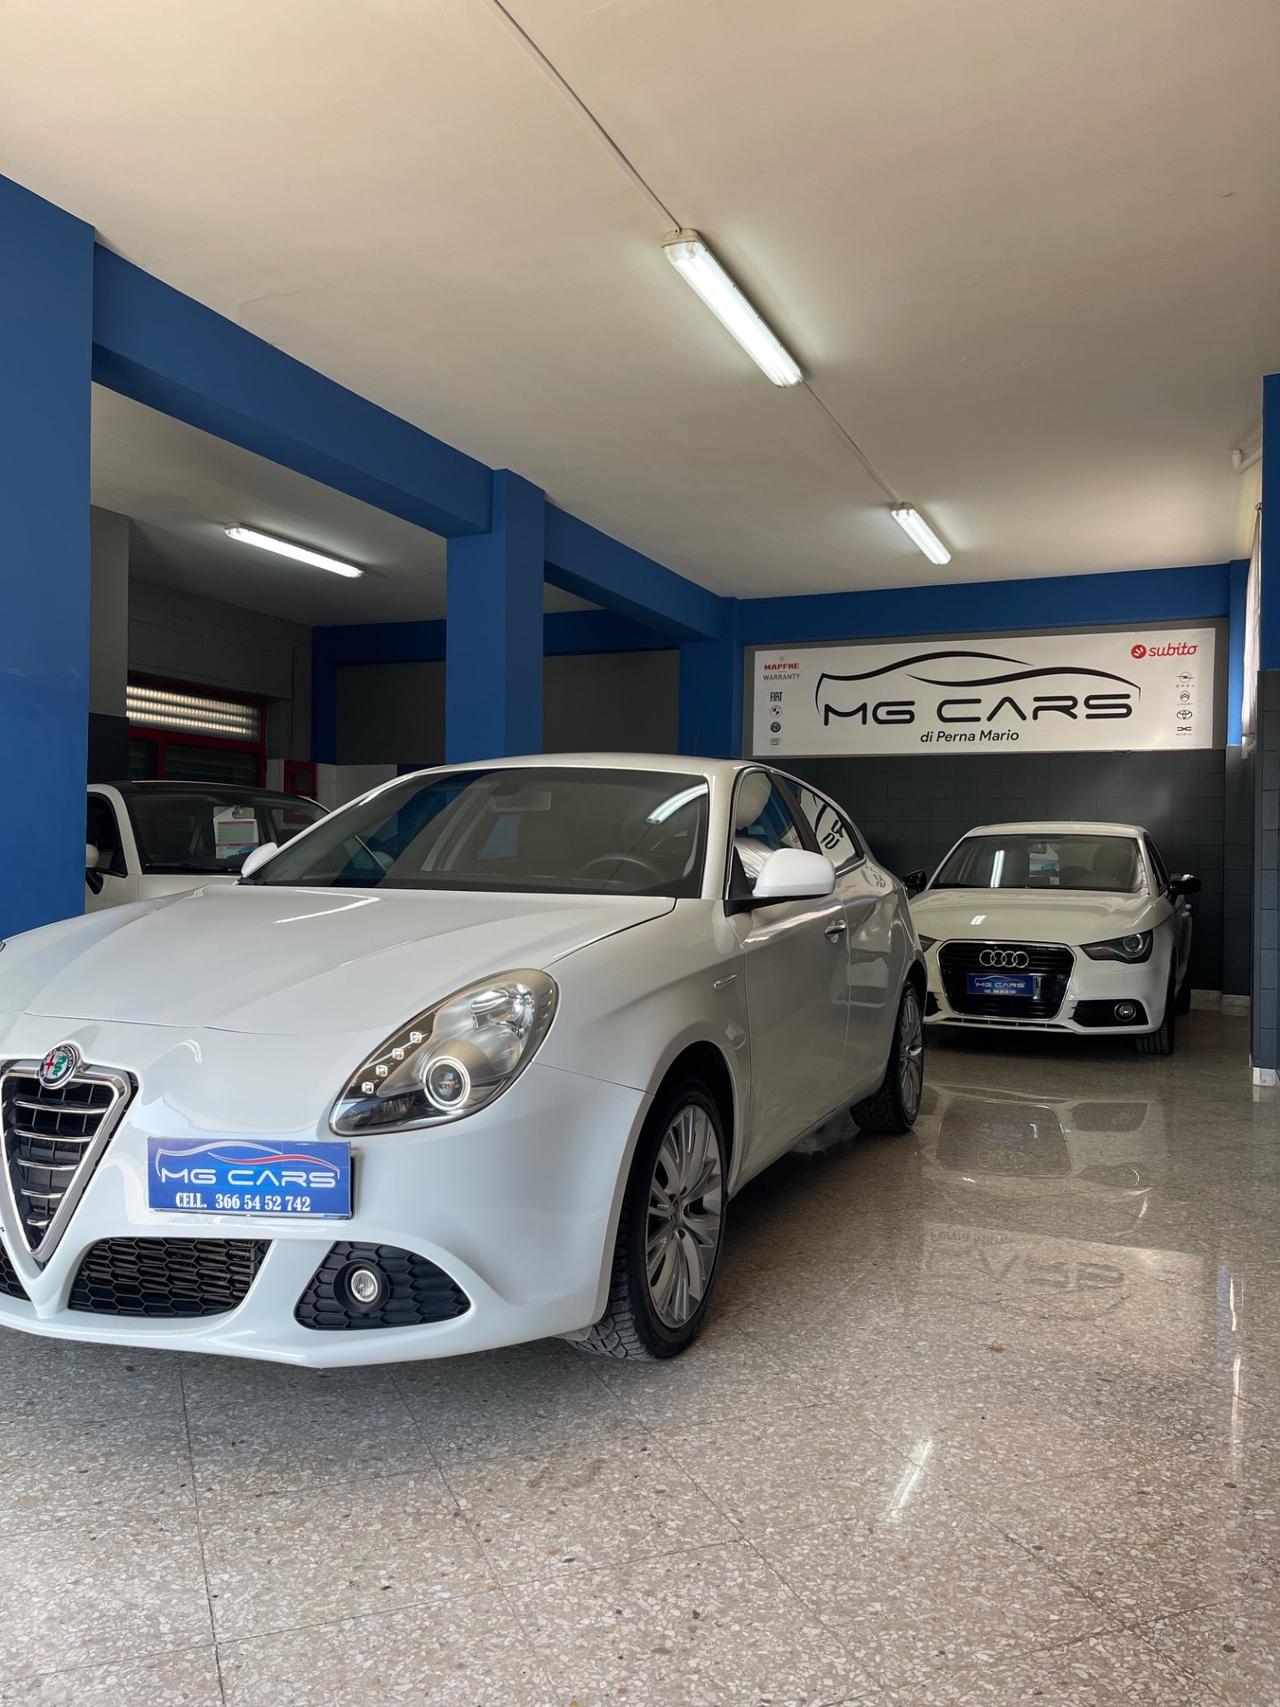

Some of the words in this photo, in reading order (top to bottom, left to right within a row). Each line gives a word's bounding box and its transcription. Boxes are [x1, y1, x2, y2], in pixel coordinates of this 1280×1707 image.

[1148, 642, 1198, 657] subito
[764, 663, 800, 671] MAPFRE
[763, 673, 801, 681] WARRANTY
[770, 691, 783, 702] FIAT
[824, 700, 916, 726] MG
[936, 693, 1133, 723] CARS
[920, 731, 934, 743] di
[936, 730, 976, 742] Perna
[979, 729, 1020, 741] Mario
[161, 1167, 217, 1185] MG
[227, 1169, 336, 1188] CARS
[175, 1191, 207, 1208] CELL.
[215, 1194, 241, 1210] 366
[244, 1194, 261, 1210] 54
[264, 1195, 282, 1211] 52
[285, 1196, 311, 1212] 742
